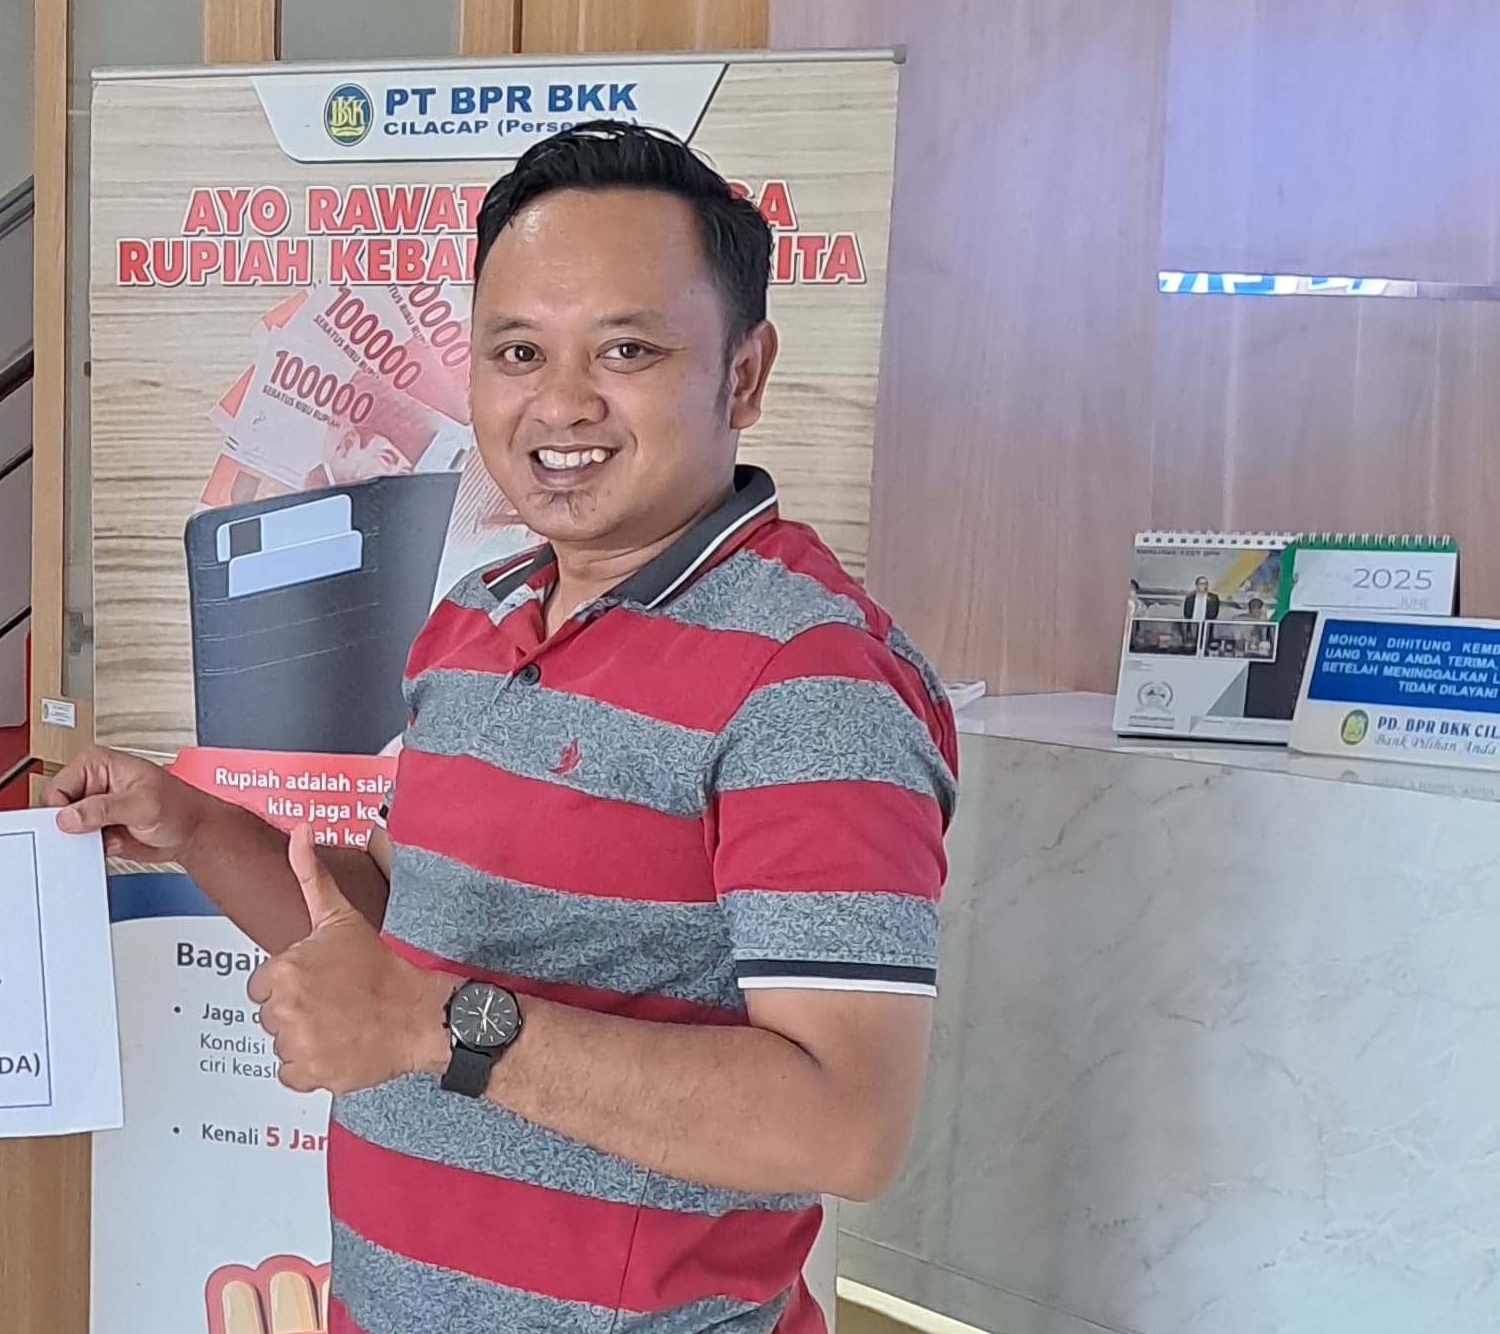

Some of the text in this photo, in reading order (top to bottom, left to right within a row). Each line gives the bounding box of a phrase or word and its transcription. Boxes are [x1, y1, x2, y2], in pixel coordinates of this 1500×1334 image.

[385, 82, 639, 116] PT BPR BKK
[384, 120, 488, 136] CILACAP
[183, 186, 290, 234] AYO
[117, 238, 312, 286] RUPIAH
[768, 232, 866, 283] ITA
[325, 286, 422, 390] 100000
[270, 350, 374, 424] 100000
[262, 384, 295, 407] SERATUS
[294, 399, 313, 416] RIBU
[1352, 568, 1433, 590] 2025
[1328, 633, 1377, 647] MOHON
[1386, 637, 1451, 652] DIHITUNG
[1325, 648, 1360, 660] UANG
[1366, 650, 1399, 664] YANG
[1404, 653, 1441, 666] ANDA
[1322, 662, 1378, 676] SETELAH
[1383, 665, 1488, 685] MENINGGALKAN
[1399, 680, 1498, 699] TIDAK DILAYANI
[1405, 718, 1436, 734] BPR
[1439, 721, 1471, 737] BKK
[214, 767, 280, 791] Rupiah
[285, 772, 350, 792] adalah
[268, 797, 303, 817] kita
[307, 799, 350, 822] jaga
[314, 827, 338, 845] ah
[176, 942, 268, 976] Bagai
[201, 1003, 245, 1026] Jaga
[200, 1033, 266, 1055] Kondisi
[200, 1056, 281, 1079] ciri keasl
[201, 1123, 259, 1146] Kenali
[265, 1126, 280, 1147] 5
